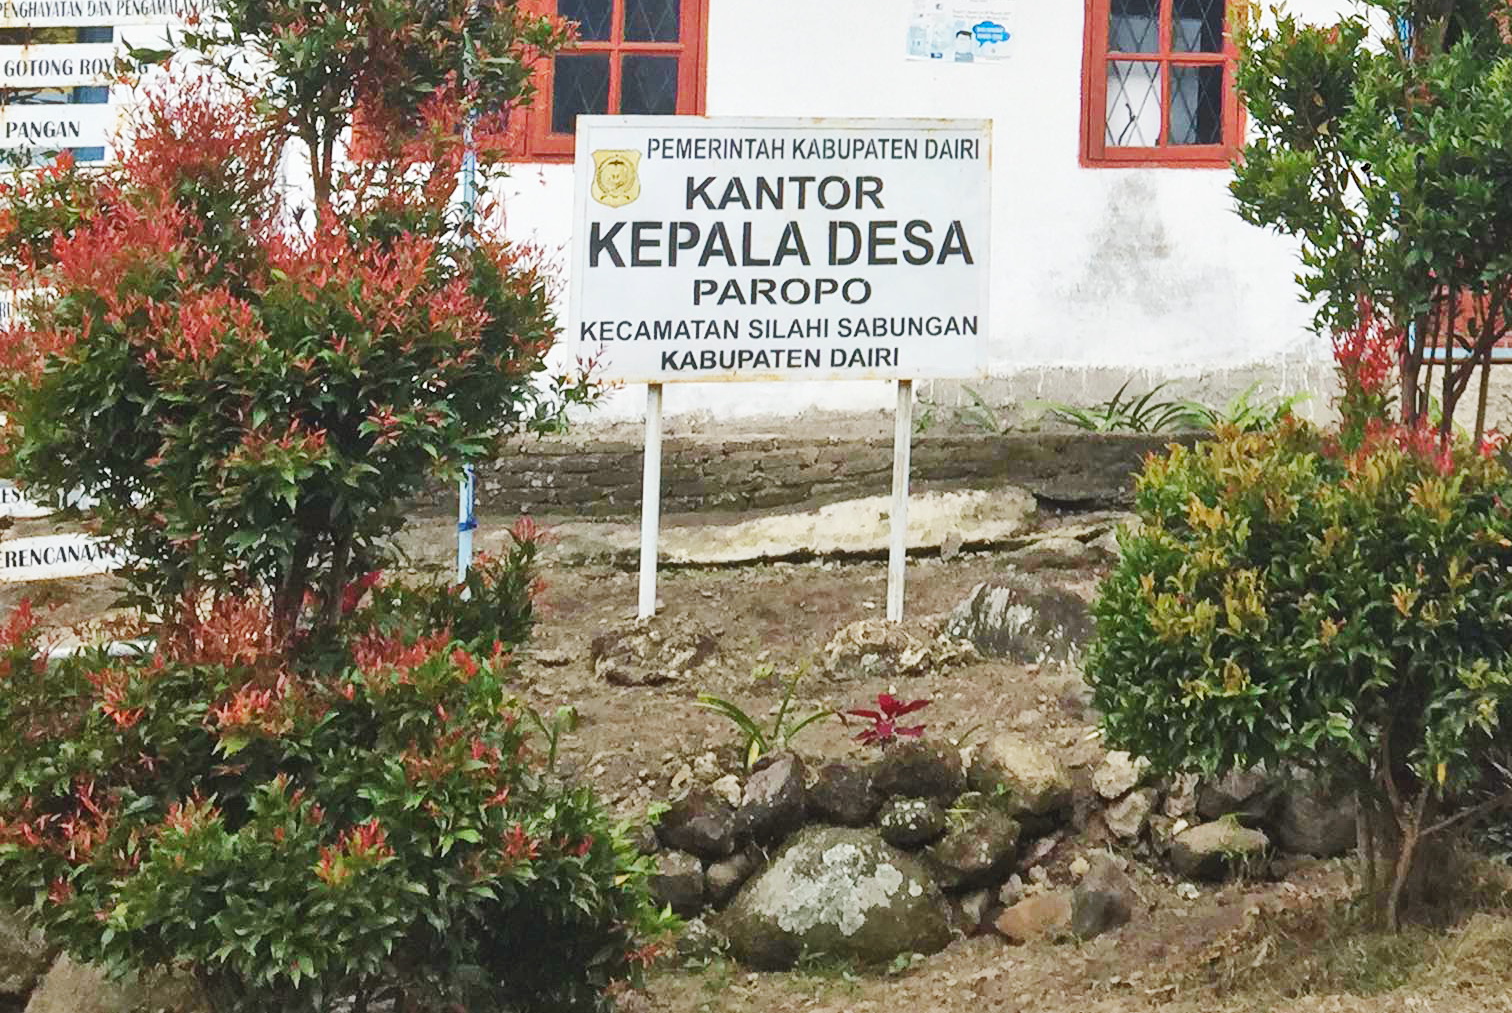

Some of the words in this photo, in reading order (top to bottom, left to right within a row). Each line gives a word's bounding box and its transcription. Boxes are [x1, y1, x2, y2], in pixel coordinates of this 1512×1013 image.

[88, 0, 112, 16] DAN
[4, 59, 73, 77] GOTONG
[80, 57, 148, 75] ROYNG
[6, 121, 81, 138] PANGAN
[647, 138, 784, 159] PEMERINTAH
[793, 138, 917, 159] KABUPATEN
[925, 138, 980, 159] DAIRI
[686, 175, 884, 210] KANTOR
[589, 221, 811, 267] KEPALA
[828, 219, 974, 265] DESA
[694, 278, 872, 305] PAROPO
[581, 320, 739, 341] KECAMATAN
[749, 319, 829, 339] SILAHI
[837, 316, 978, 337] SABUNGAN
[661, 349, 820, 370] KABUPATEN
[830, 347, 898, 368] DAIRI
